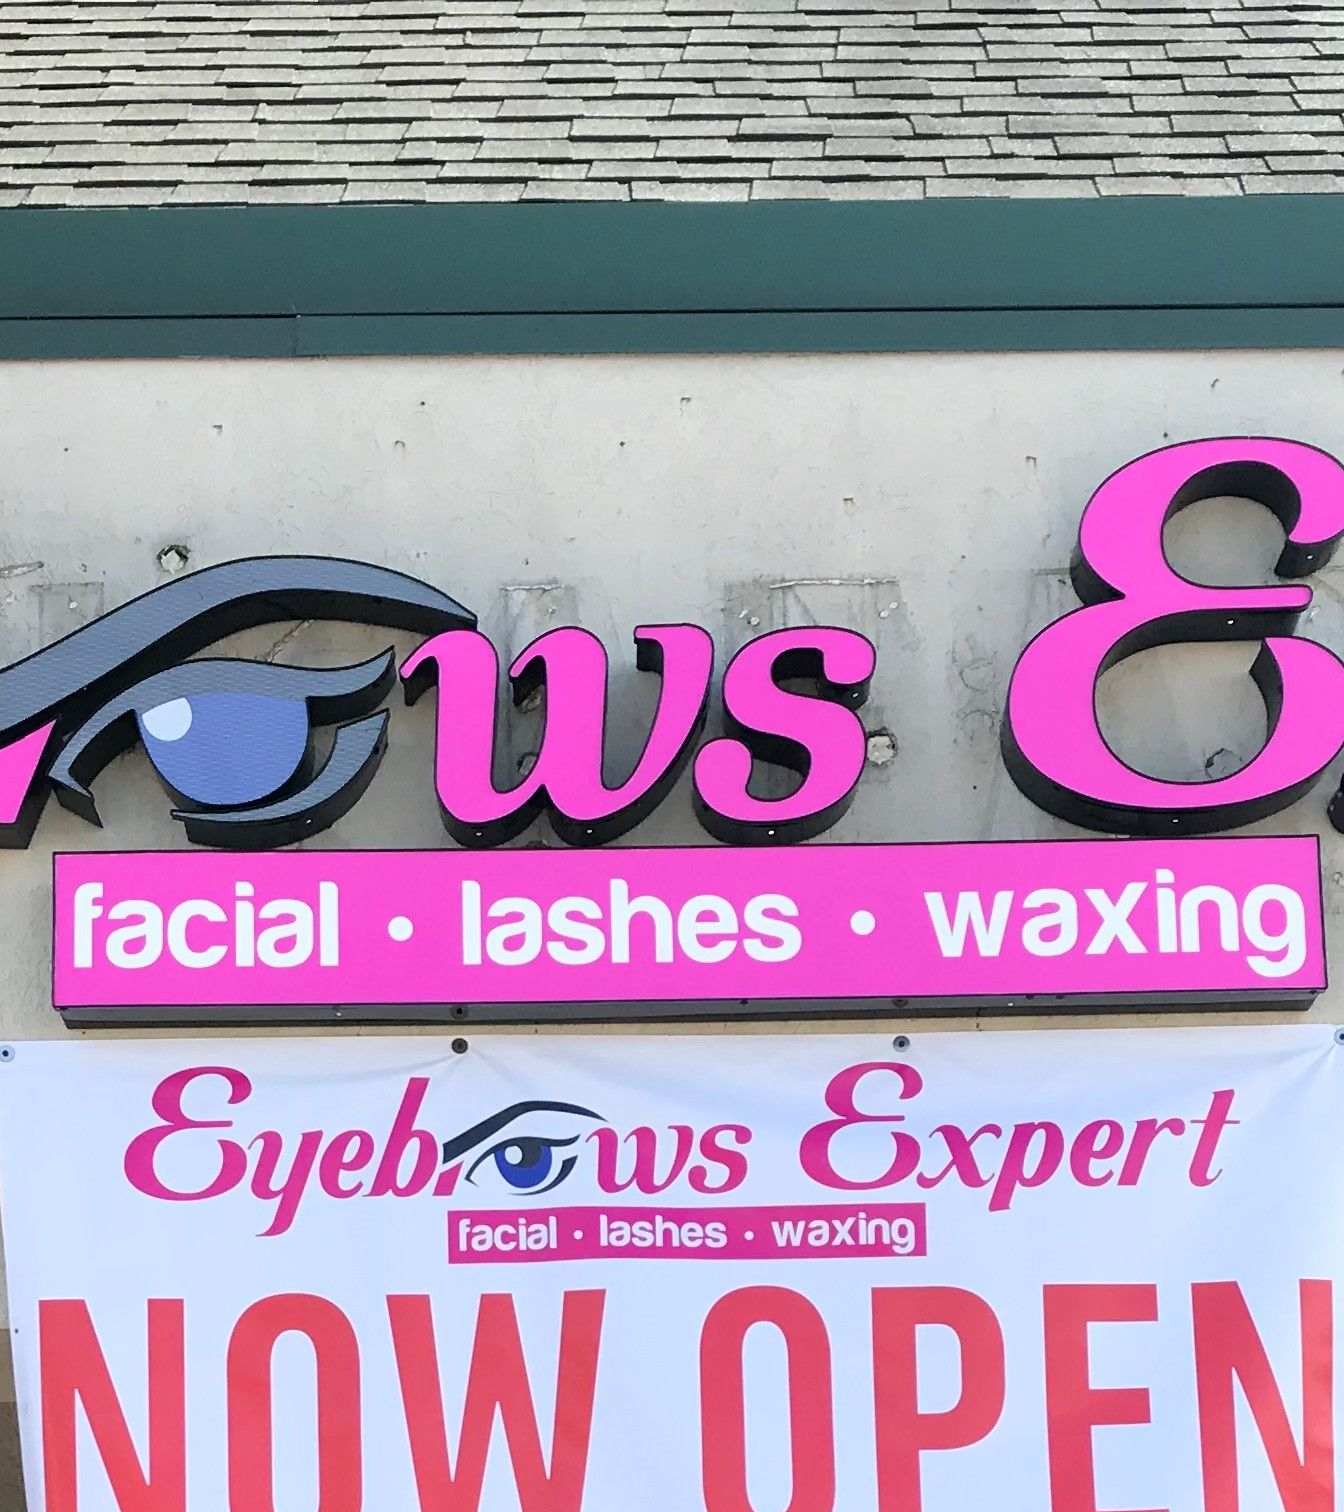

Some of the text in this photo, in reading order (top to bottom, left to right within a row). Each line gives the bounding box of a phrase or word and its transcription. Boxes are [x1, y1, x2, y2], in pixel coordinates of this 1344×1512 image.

[72, 868, 1307, 978] facial lashes waxing
[799, 1061, 1240, 1212] Expert
[458, 1210, 916, 1255] facial lashes waxing
